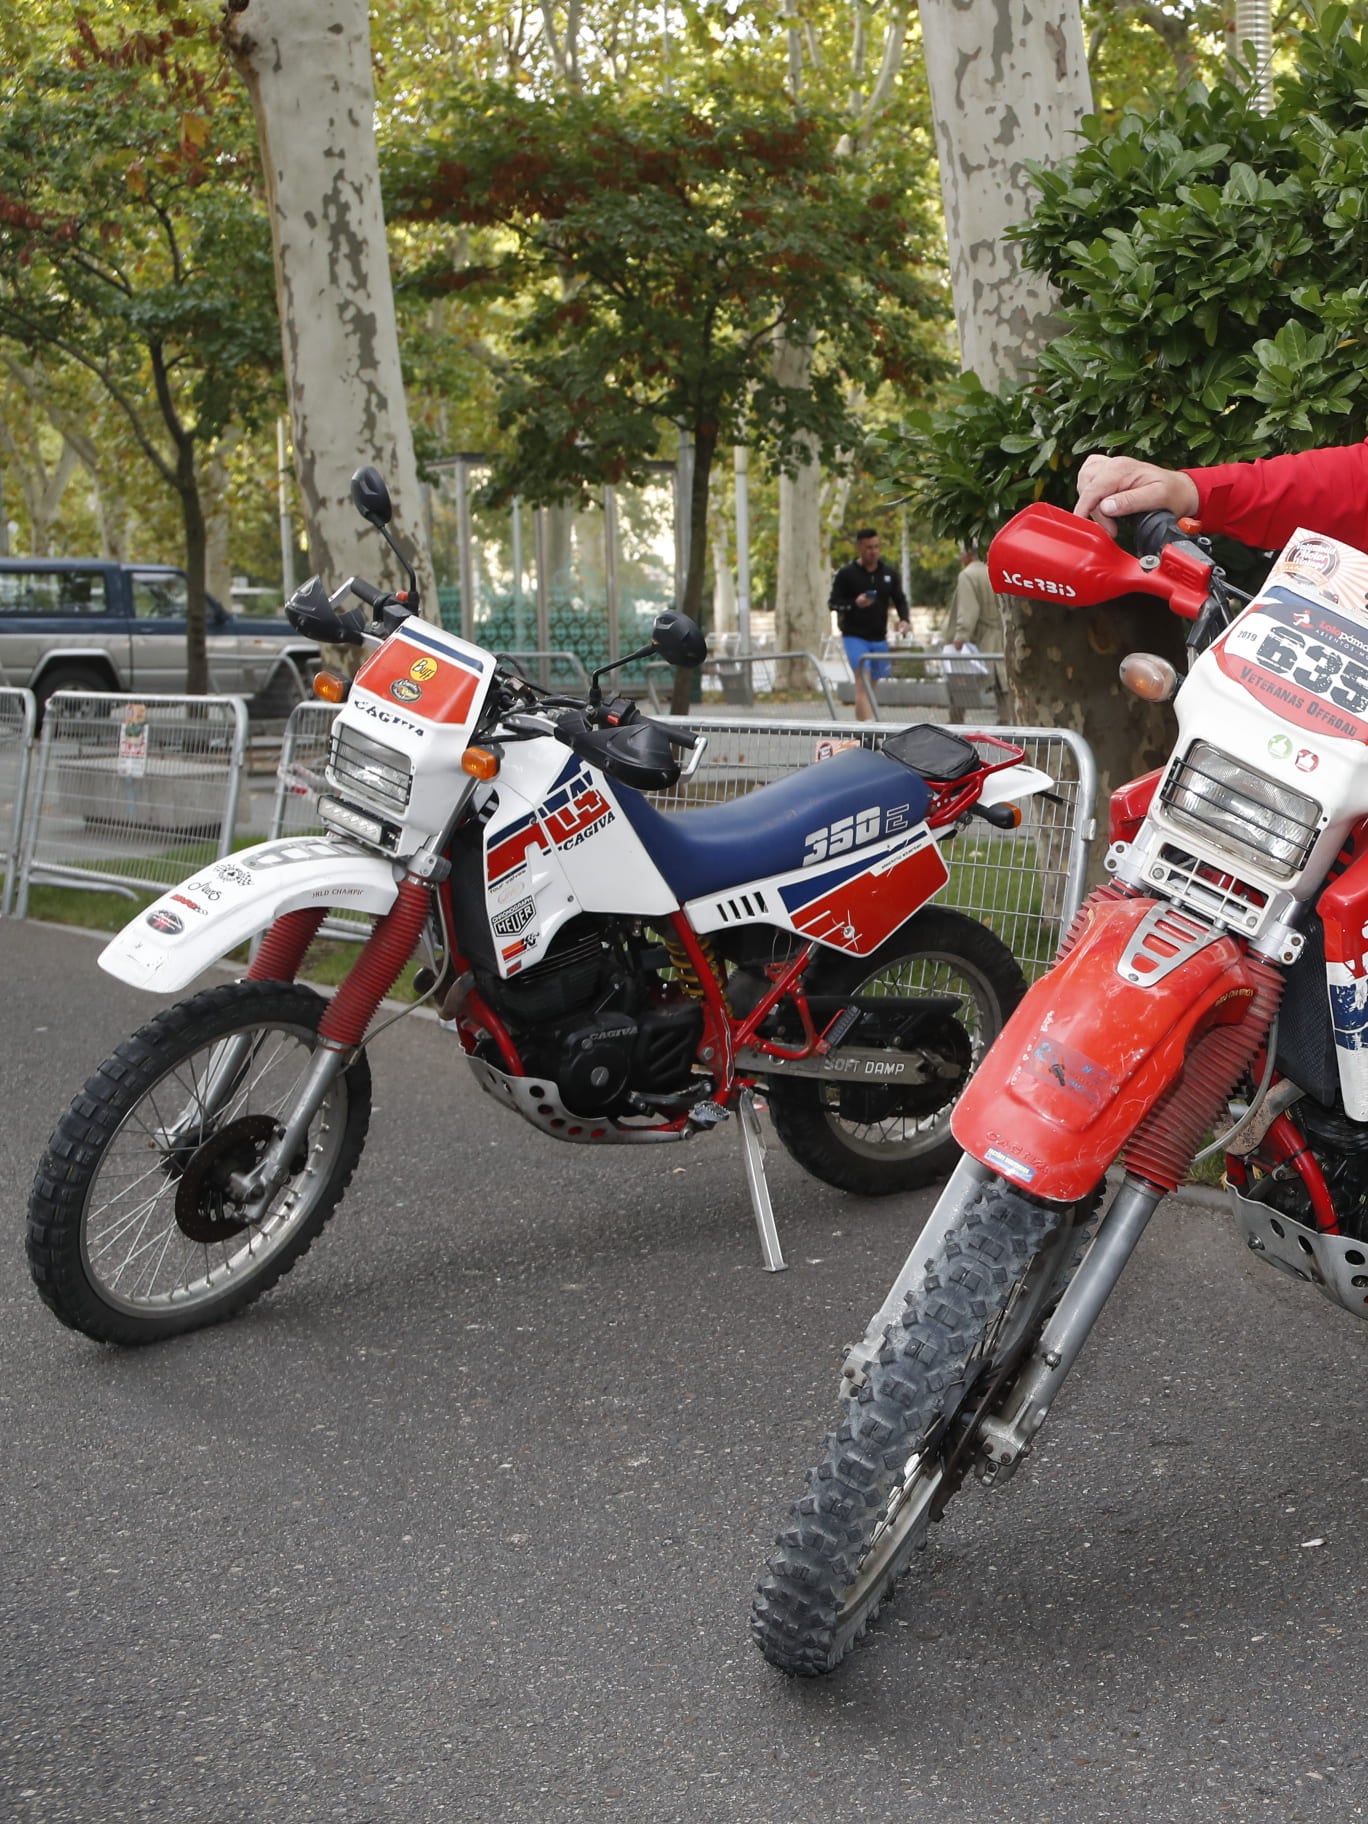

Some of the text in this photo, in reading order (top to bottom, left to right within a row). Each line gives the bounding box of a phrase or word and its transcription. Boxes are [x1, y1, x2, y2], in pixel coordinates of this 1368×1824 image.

[1237, 630, 1258, 642] 2019
[563, 810, 616, 852] CAGIVA
[802, 805, 881, 867] 350
[497, 905, 533, 933] HEUER
[824, 1058, 905, 1076] SOFT DAMP
